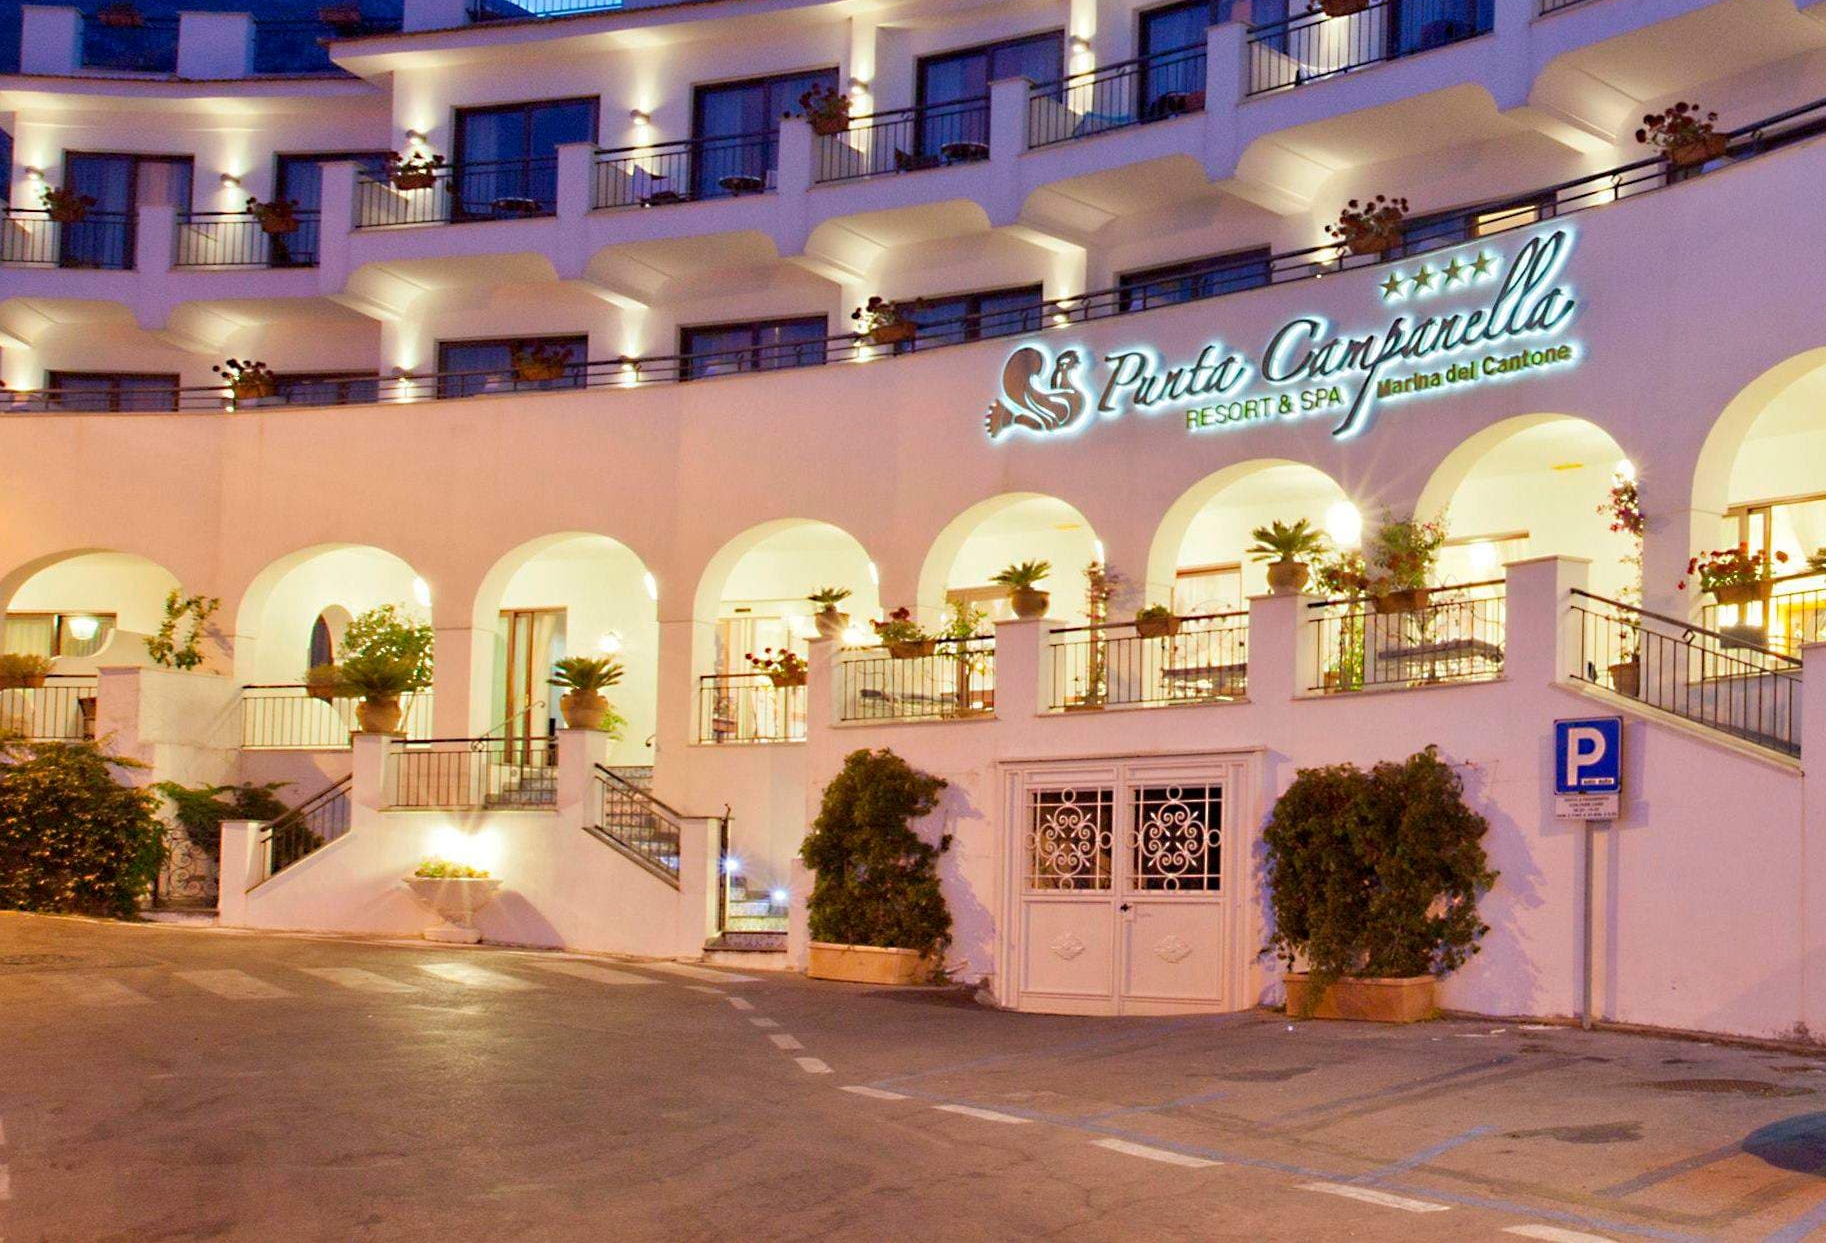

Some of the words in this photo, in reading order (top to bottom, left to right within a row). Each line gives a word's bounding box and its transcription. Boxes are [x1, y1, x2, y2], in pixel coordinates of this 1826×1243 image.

[1097, 344, 1247, 412] Punta
[1261, 230, 1576, 436] Campanella
[1377, 373, 1441, 399] Marina
[1446, 362, 1475, 383] del
[1482, 342, 1573, 376] Cantone
[1186, 397, 1271, 429] RESORT
[1278, 393, 1293, 415] &
[1300, 386, 1342, 410] SPA
[1567, 727, 1606, 786] P
